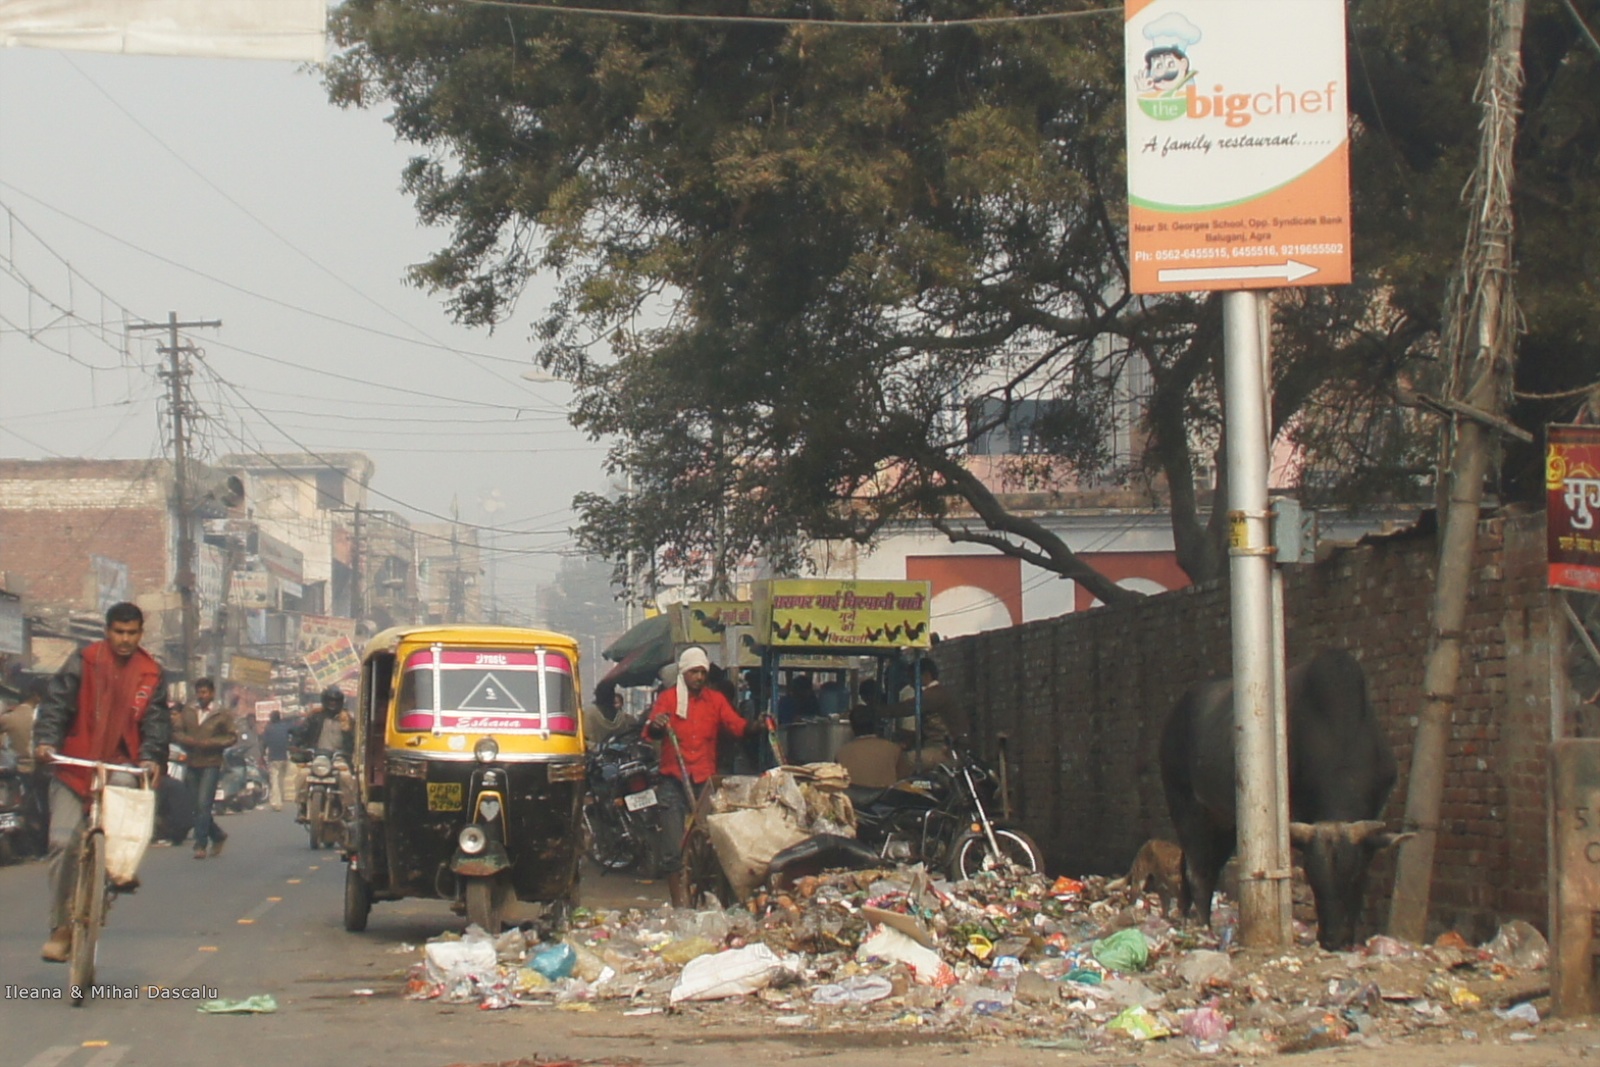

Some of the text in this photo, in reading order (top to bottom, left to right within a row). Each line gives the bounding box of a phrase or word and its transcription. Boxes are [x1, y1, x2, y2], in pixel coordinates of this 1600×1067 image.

[1152, 102, 1178, 117] the
[1142, 135, 1158, 153] A
[1162, 133, 1212, 157] family
[1134, 222, 1154, 233] Near
[1172, 221, 1210, 233] Georges
[1273, 216, 1317, 228] Syndicate
[1320, 215, 1343, 226] Bank
[1250, 231, 1272, 242] Agra
[1135, 251, 1152, 262] Ph:
